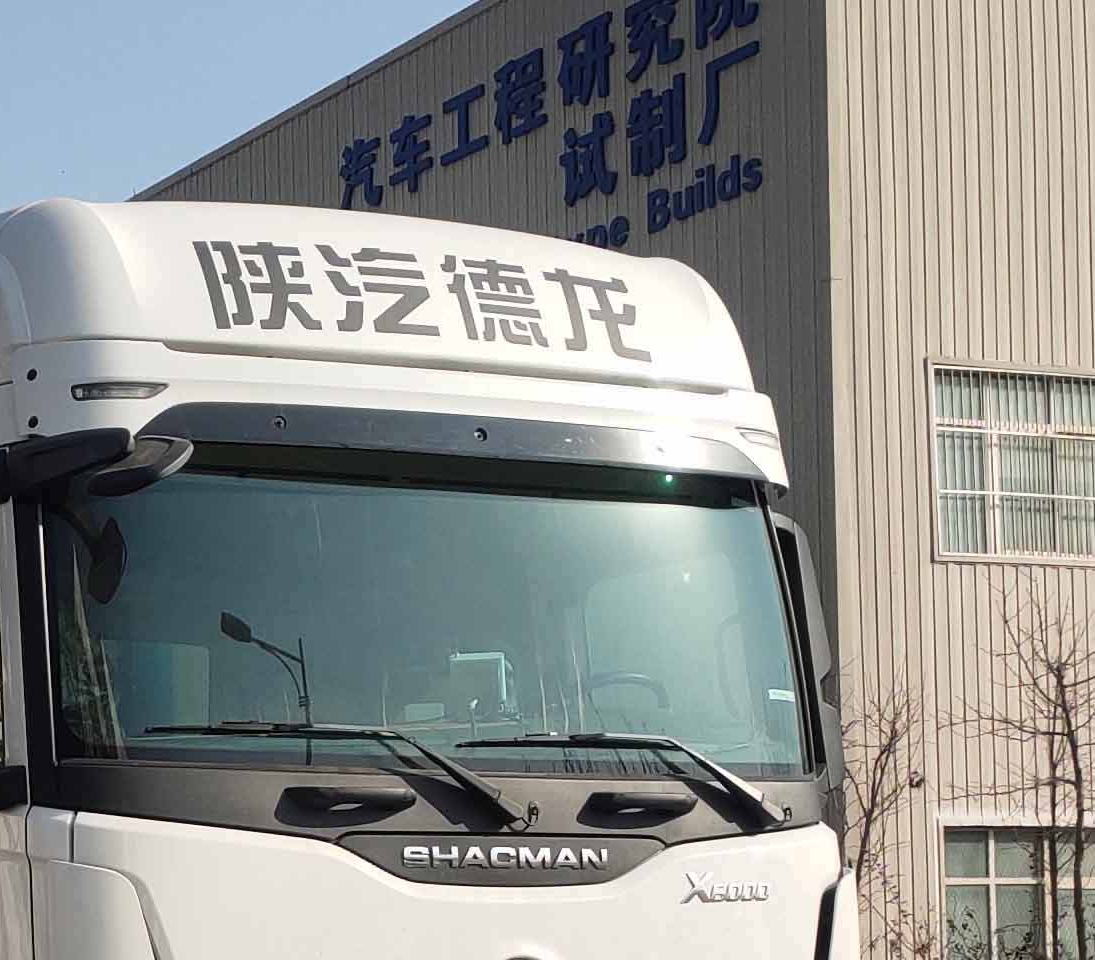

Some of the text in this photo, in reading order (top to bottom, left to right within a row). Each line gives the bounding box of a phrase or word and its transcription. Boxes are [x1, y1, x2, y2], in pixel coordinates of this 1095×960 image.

[558, 40, 761, 207] 试制厂
[647, 154, 763, 234] Builds
[192, 240, 652, 363] 陕汽德龙
[403, 845, 609, 870] SHACMAN
